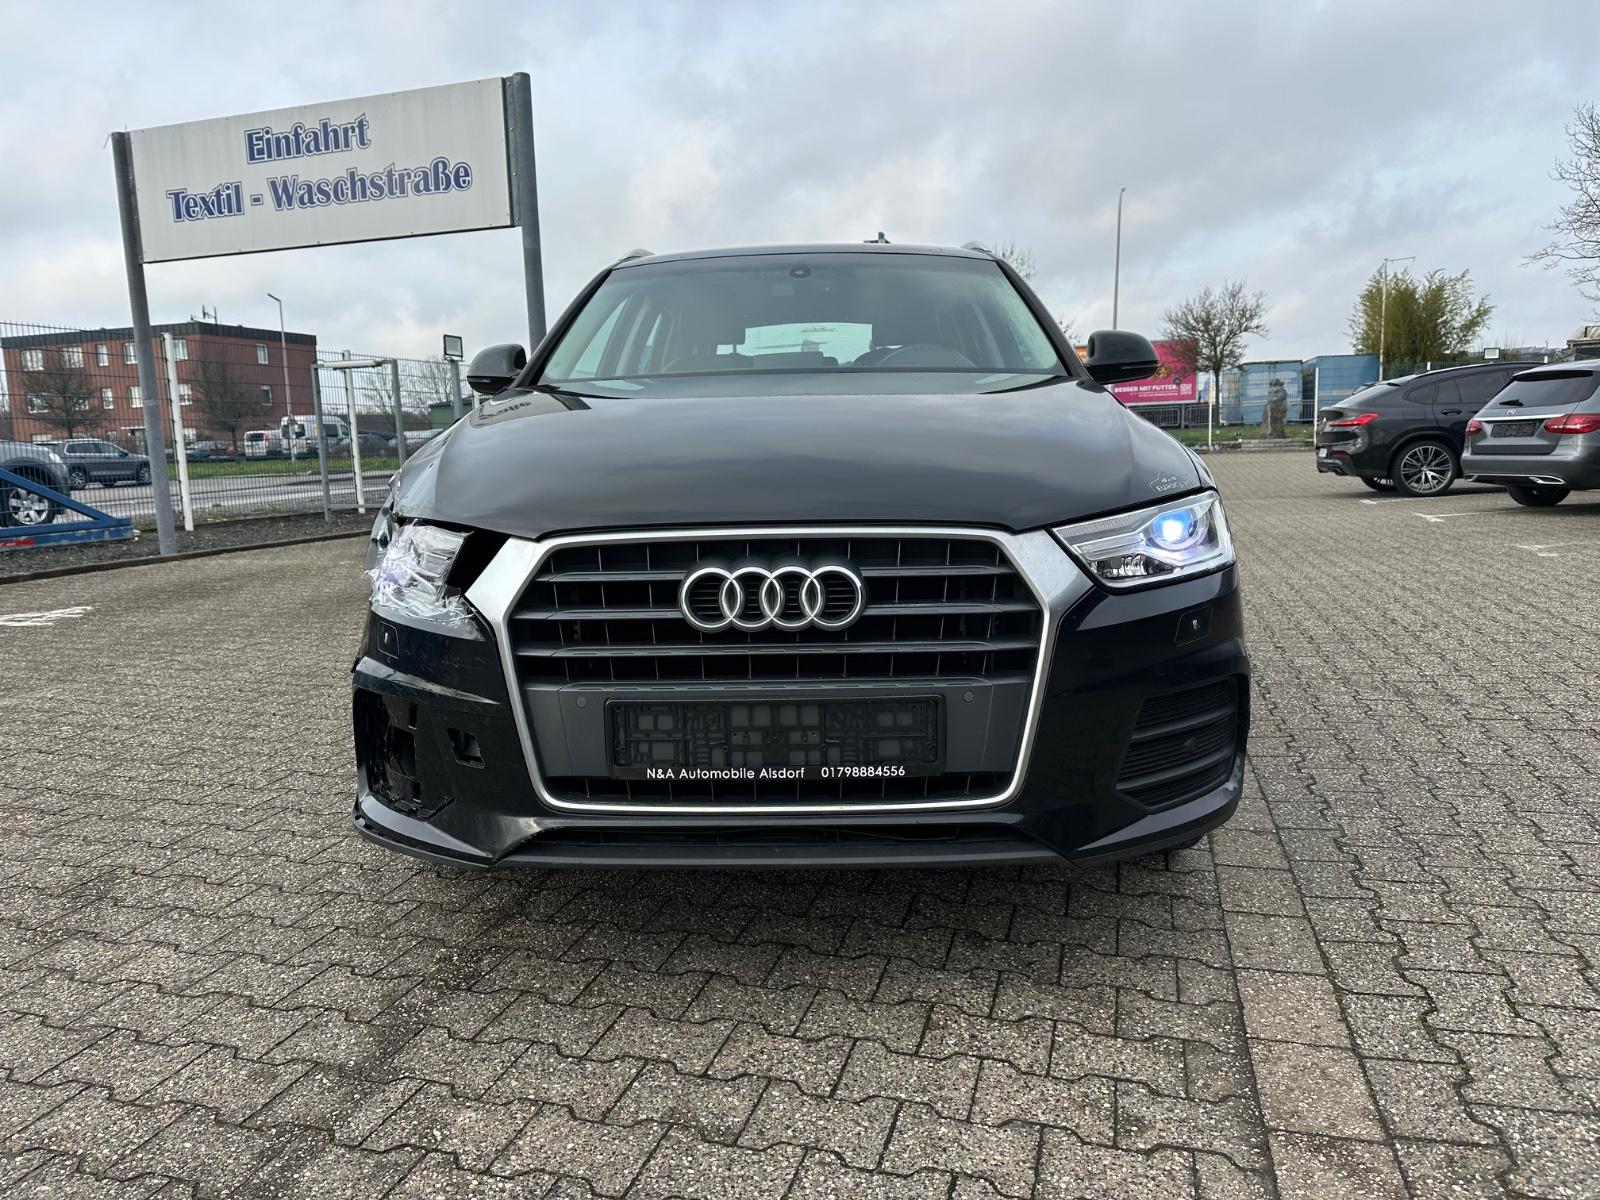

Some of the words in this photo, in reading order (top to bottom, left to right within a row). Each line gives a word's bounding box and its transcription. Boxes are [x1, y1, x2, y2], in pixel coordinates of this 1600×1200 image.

[244, 113, 371, 165] Einfahrt
[166, 181, 244, 223] Textil
[266, 156, 474, 211] Waschstraße
[646, 768, 675, 779] N&A
[679, 767, 755, 779] Automobile
[759, 767, 805, 779] Alsdorf
[821, 765, 906, 778] 01798884556
